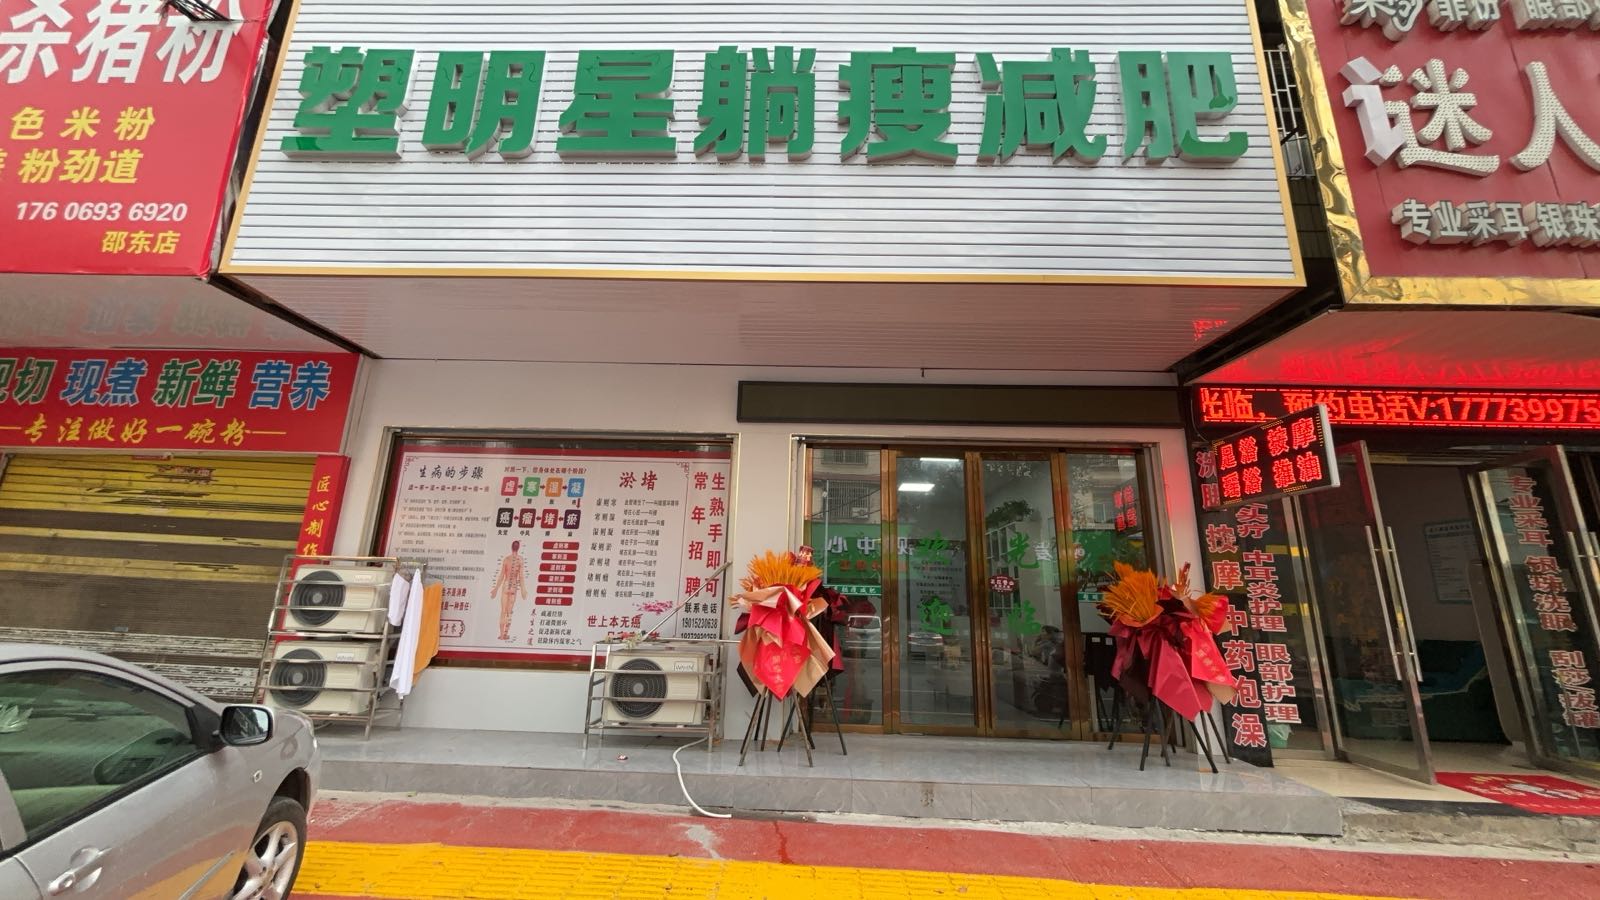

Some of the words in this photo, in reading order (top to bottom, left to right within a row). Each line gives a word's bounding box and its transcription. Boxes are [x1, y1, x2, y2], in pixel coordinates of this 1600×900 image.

[10, 107, 155, 141] 色米粉
[281, 46, 1248, 162] 塑明星躺瘦减肥
[15, 202, 59, 222] 176
[63, 203, 121, 222] 0693
[127, 203, 188, 222] 6920
[1400, 199, 1529, 240] 专业采耳
[102, 231, 181, 254] 邵东店
[61, 359, 148, 406] 现煮
[152, 359, 241, 408] 新鲜
[248, 360, 332, 411] 营养
[24, 412, 250, 447] 专注做好一碗粉
[418, 464, 485, 480] 生病的步骤
[302, 474, 331, 556] 匠心制作
[684, 472, 709, 598] 常年招聘
[704, 472, 726, 598] 生熟手即可
[1508, 474, 1555, 547] 专业采耳
[1205, 523, 1244, 591] 按摩
[684, 602, 718, 615] 联系电话
[1242, 550, 1288, 633] 中耳炎护理
[587, 612, 643, 629] 世上本无癌
[1254, 643, 1302, 724] 眼部护理
